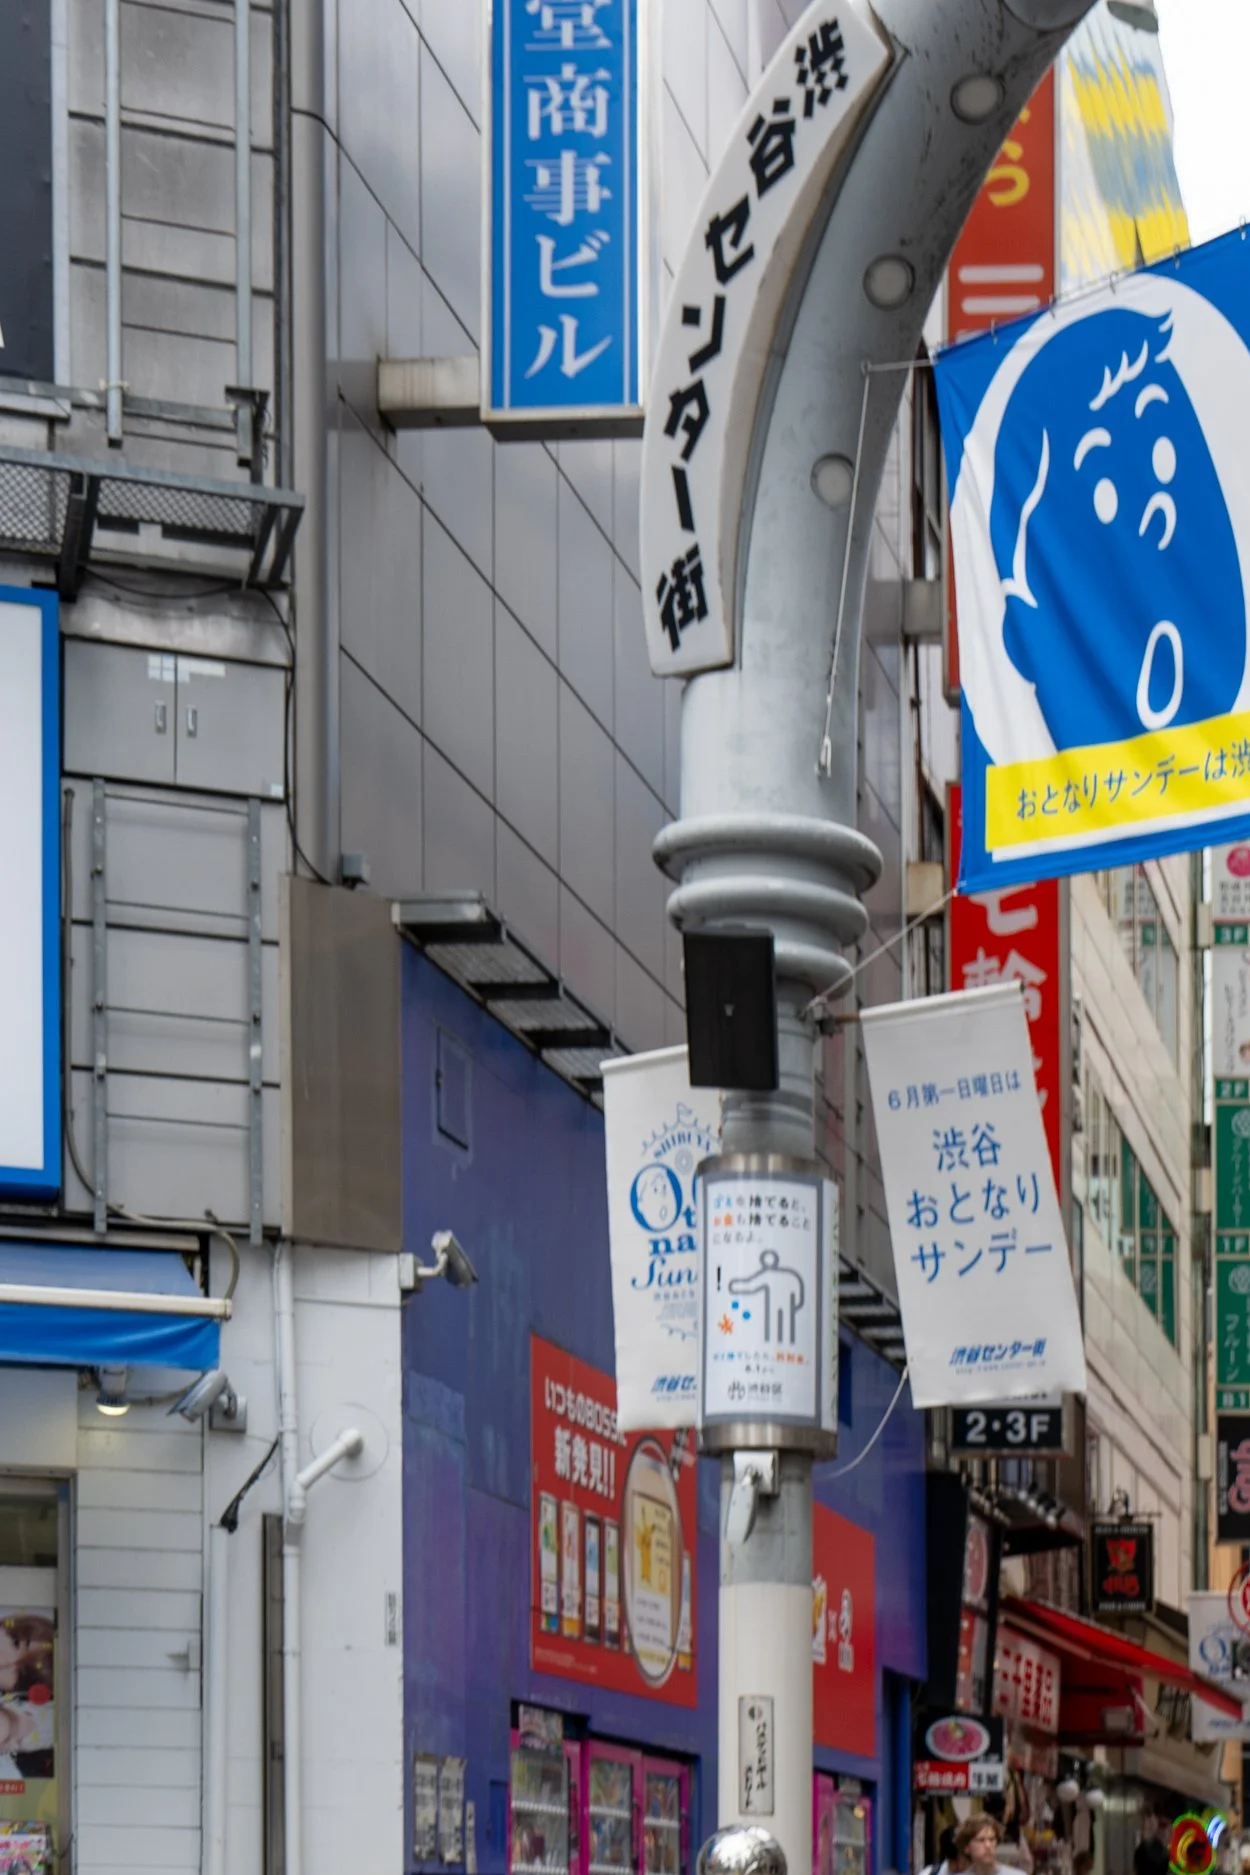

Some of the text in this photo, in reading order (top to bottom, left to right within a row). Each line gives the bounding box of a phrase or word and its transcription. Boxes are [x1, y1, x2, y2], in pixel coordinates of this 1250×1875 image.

[655, 19, 851, 653] 渋谷センター街
[1220, 928, 1245, 942] 3F
[888, 1070, 1022, 1111] 6月第一日曜日は
[1220, 1082, 1245, 1096] 2F
[931, 1122, 1002, 1172] 渋谷
[906, 1172, 1040, 1230] おとなり
[910, 1228, 1053, 1284] サンデー
[948, 1337, 1047, 1368] 渋谷センター街
